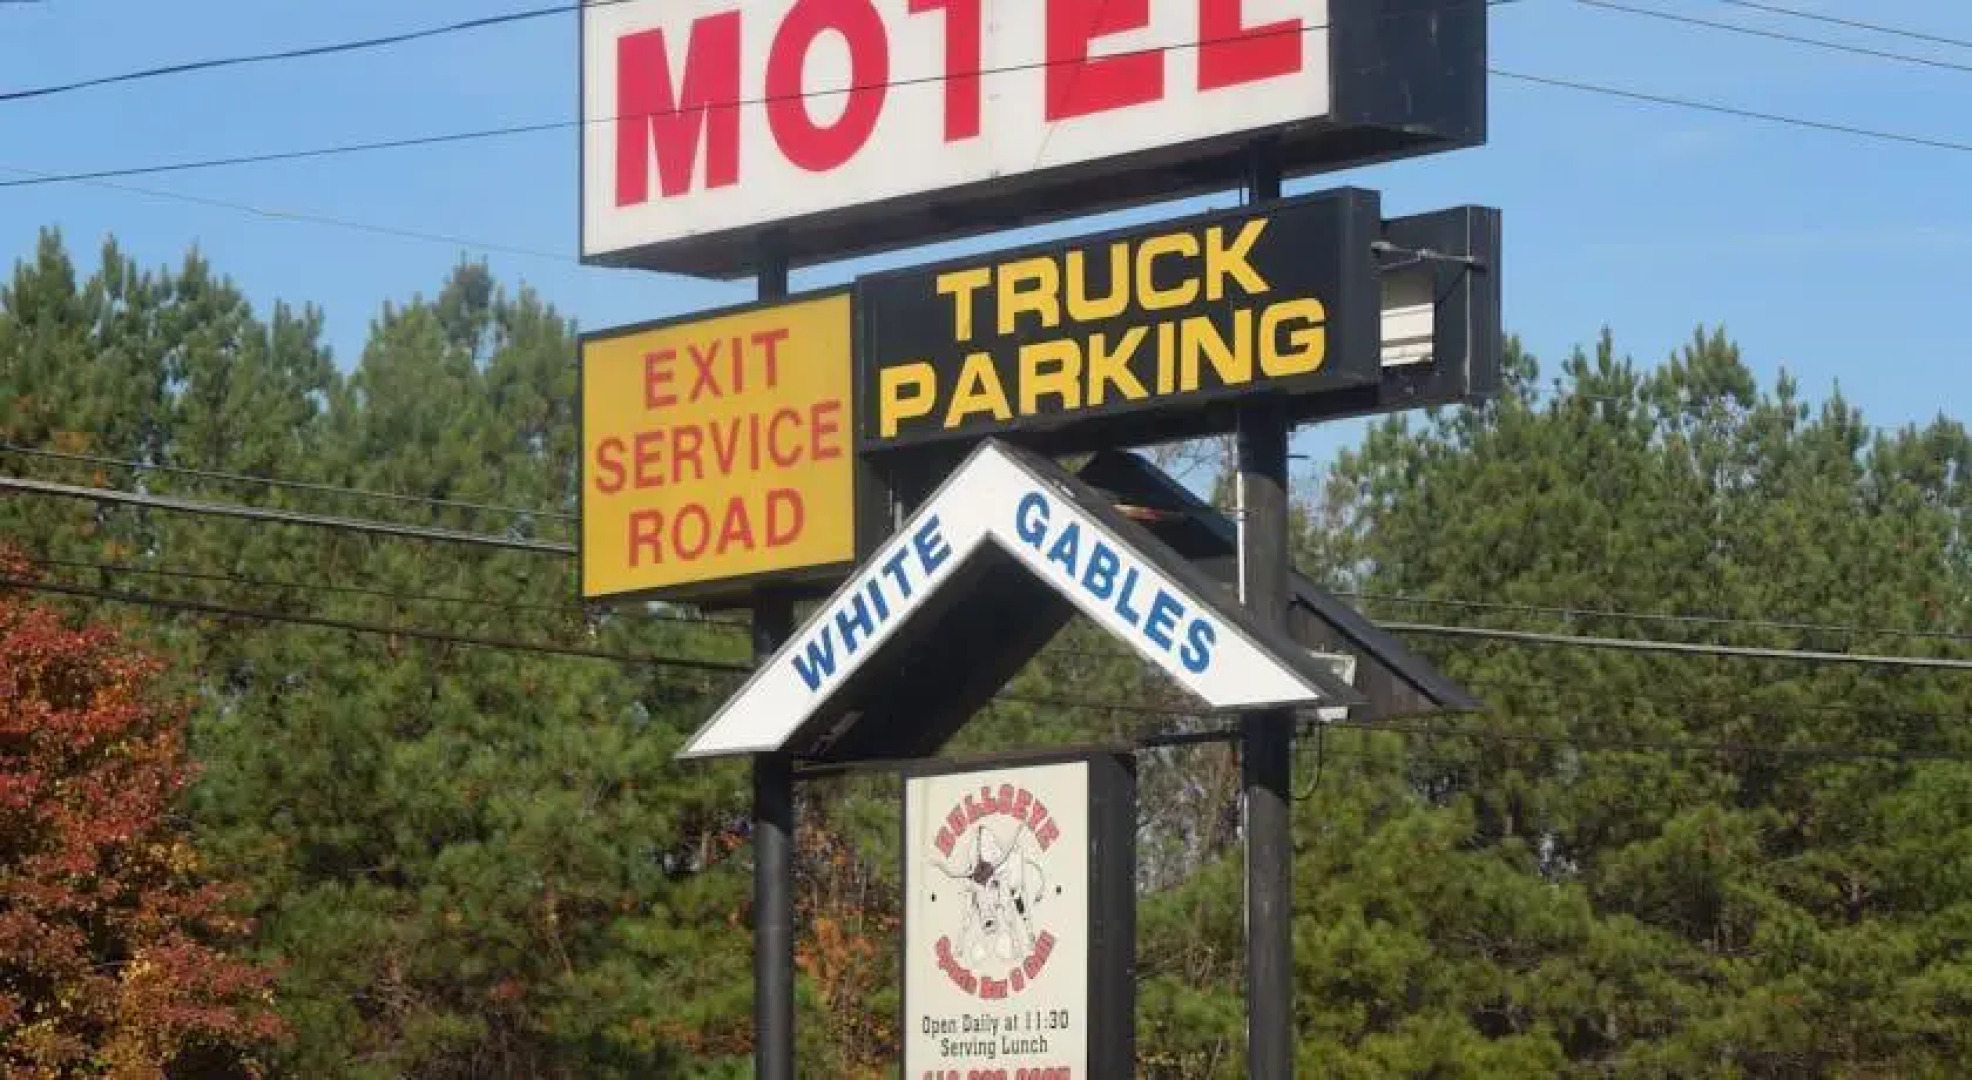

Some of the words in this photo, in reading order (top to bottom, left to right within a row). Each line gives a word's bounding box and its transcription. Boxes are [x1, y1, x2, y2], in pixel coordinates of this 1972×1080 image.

[936, 217, 1269, 342] TRUCK
[643, 328, 789, 410] EXIT
[879, 297, 1326, 438] PARKING
[595, 400, 843, 495] SERVICE
[627, 488, 805, 568] ROAD
[793, 514, 951, 693] WHITE
[1015, 492, 1217, 674] GABLES
[922, 1014, 957, 1040] Open
[962, 1013, 999, 1036] Daily
[1004, 1013, 1018, 1031] at
[1025, 1009, 1069, 1031] 11:30
[940, 1037, 997, 1060] Serving
[1001, 1034, 1048, 1055] Lunch
